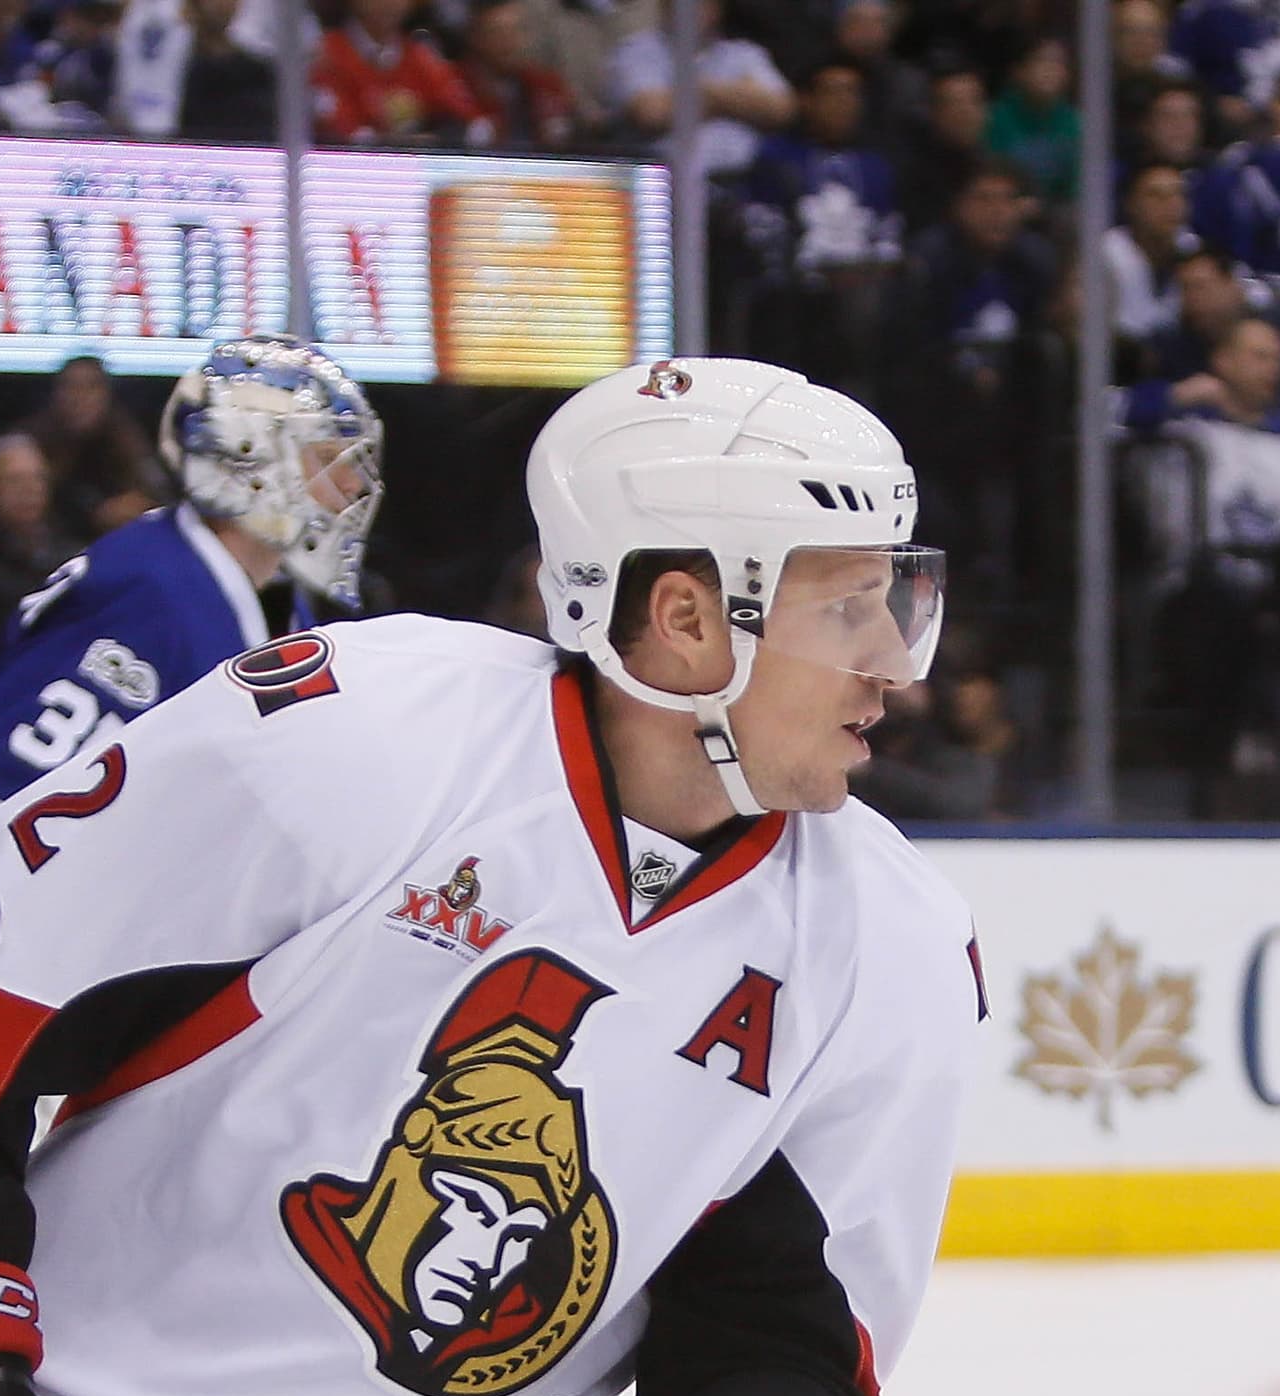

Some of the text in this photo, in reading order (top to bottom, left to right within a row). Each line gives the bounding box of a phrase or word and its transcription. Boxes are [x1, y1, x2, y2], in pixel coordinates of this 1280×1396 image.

[9, 742, 127, 874] 2
[385, 883, 515, 954] XXV
[676, 963, 783, 1097] A
